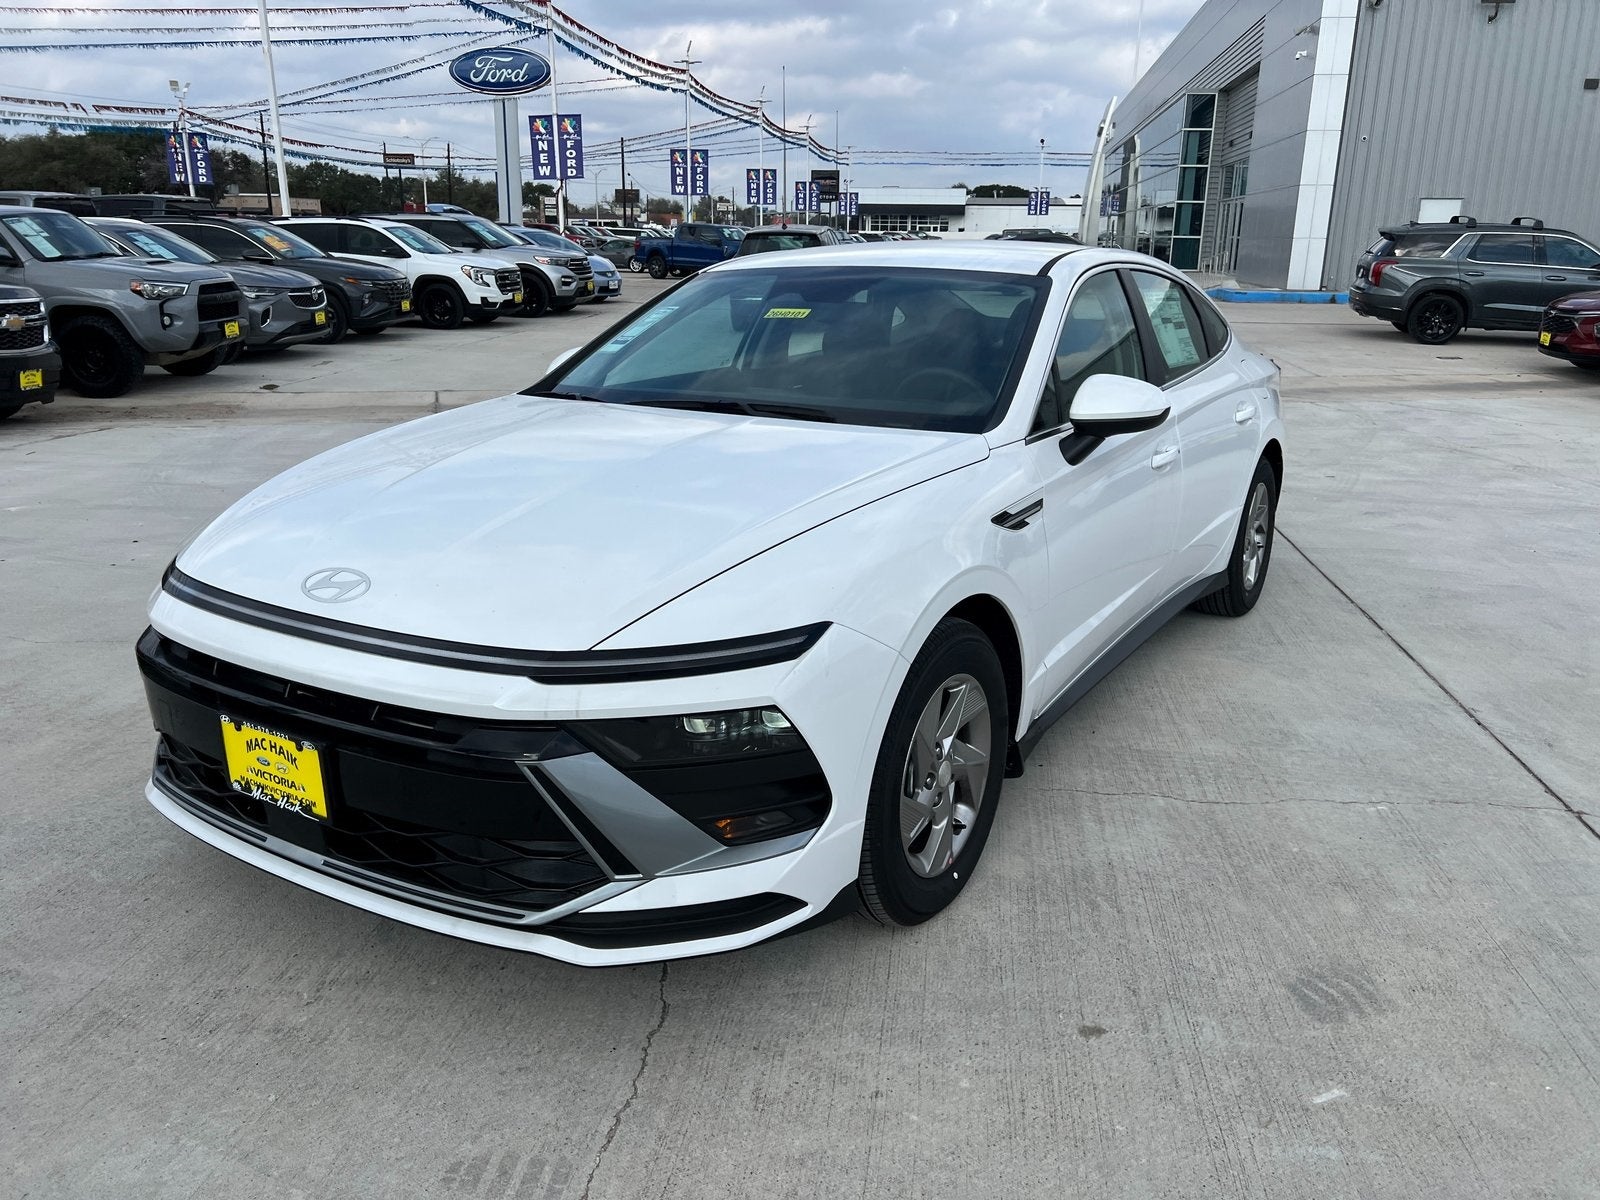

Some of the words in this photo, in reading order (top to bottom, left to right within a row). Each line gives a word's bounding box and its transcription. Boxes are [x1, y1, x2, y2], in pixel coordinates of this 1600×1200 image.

[469, 54, 529, 84] Ford
[196, 153, 207, 183] FORD
[538, 140, 551, 176] NEW
[565, 140, 577, 177] FORD
[675, 167, 685, 194] NEW
[695, 167, 704, 194] FORD
[749, 182, 758, 204] NEW
[766, 182, 774, 204] FORD
[797, 192, 805, 210] NEW
[246, 738, 267, 753] MAC
[269, 741, 299, 769] HAIK
[252, 766, 297, 791] VICTORIA
[251, 786, 272, 802] Mac
[276, 797, 302, 813] Haik
